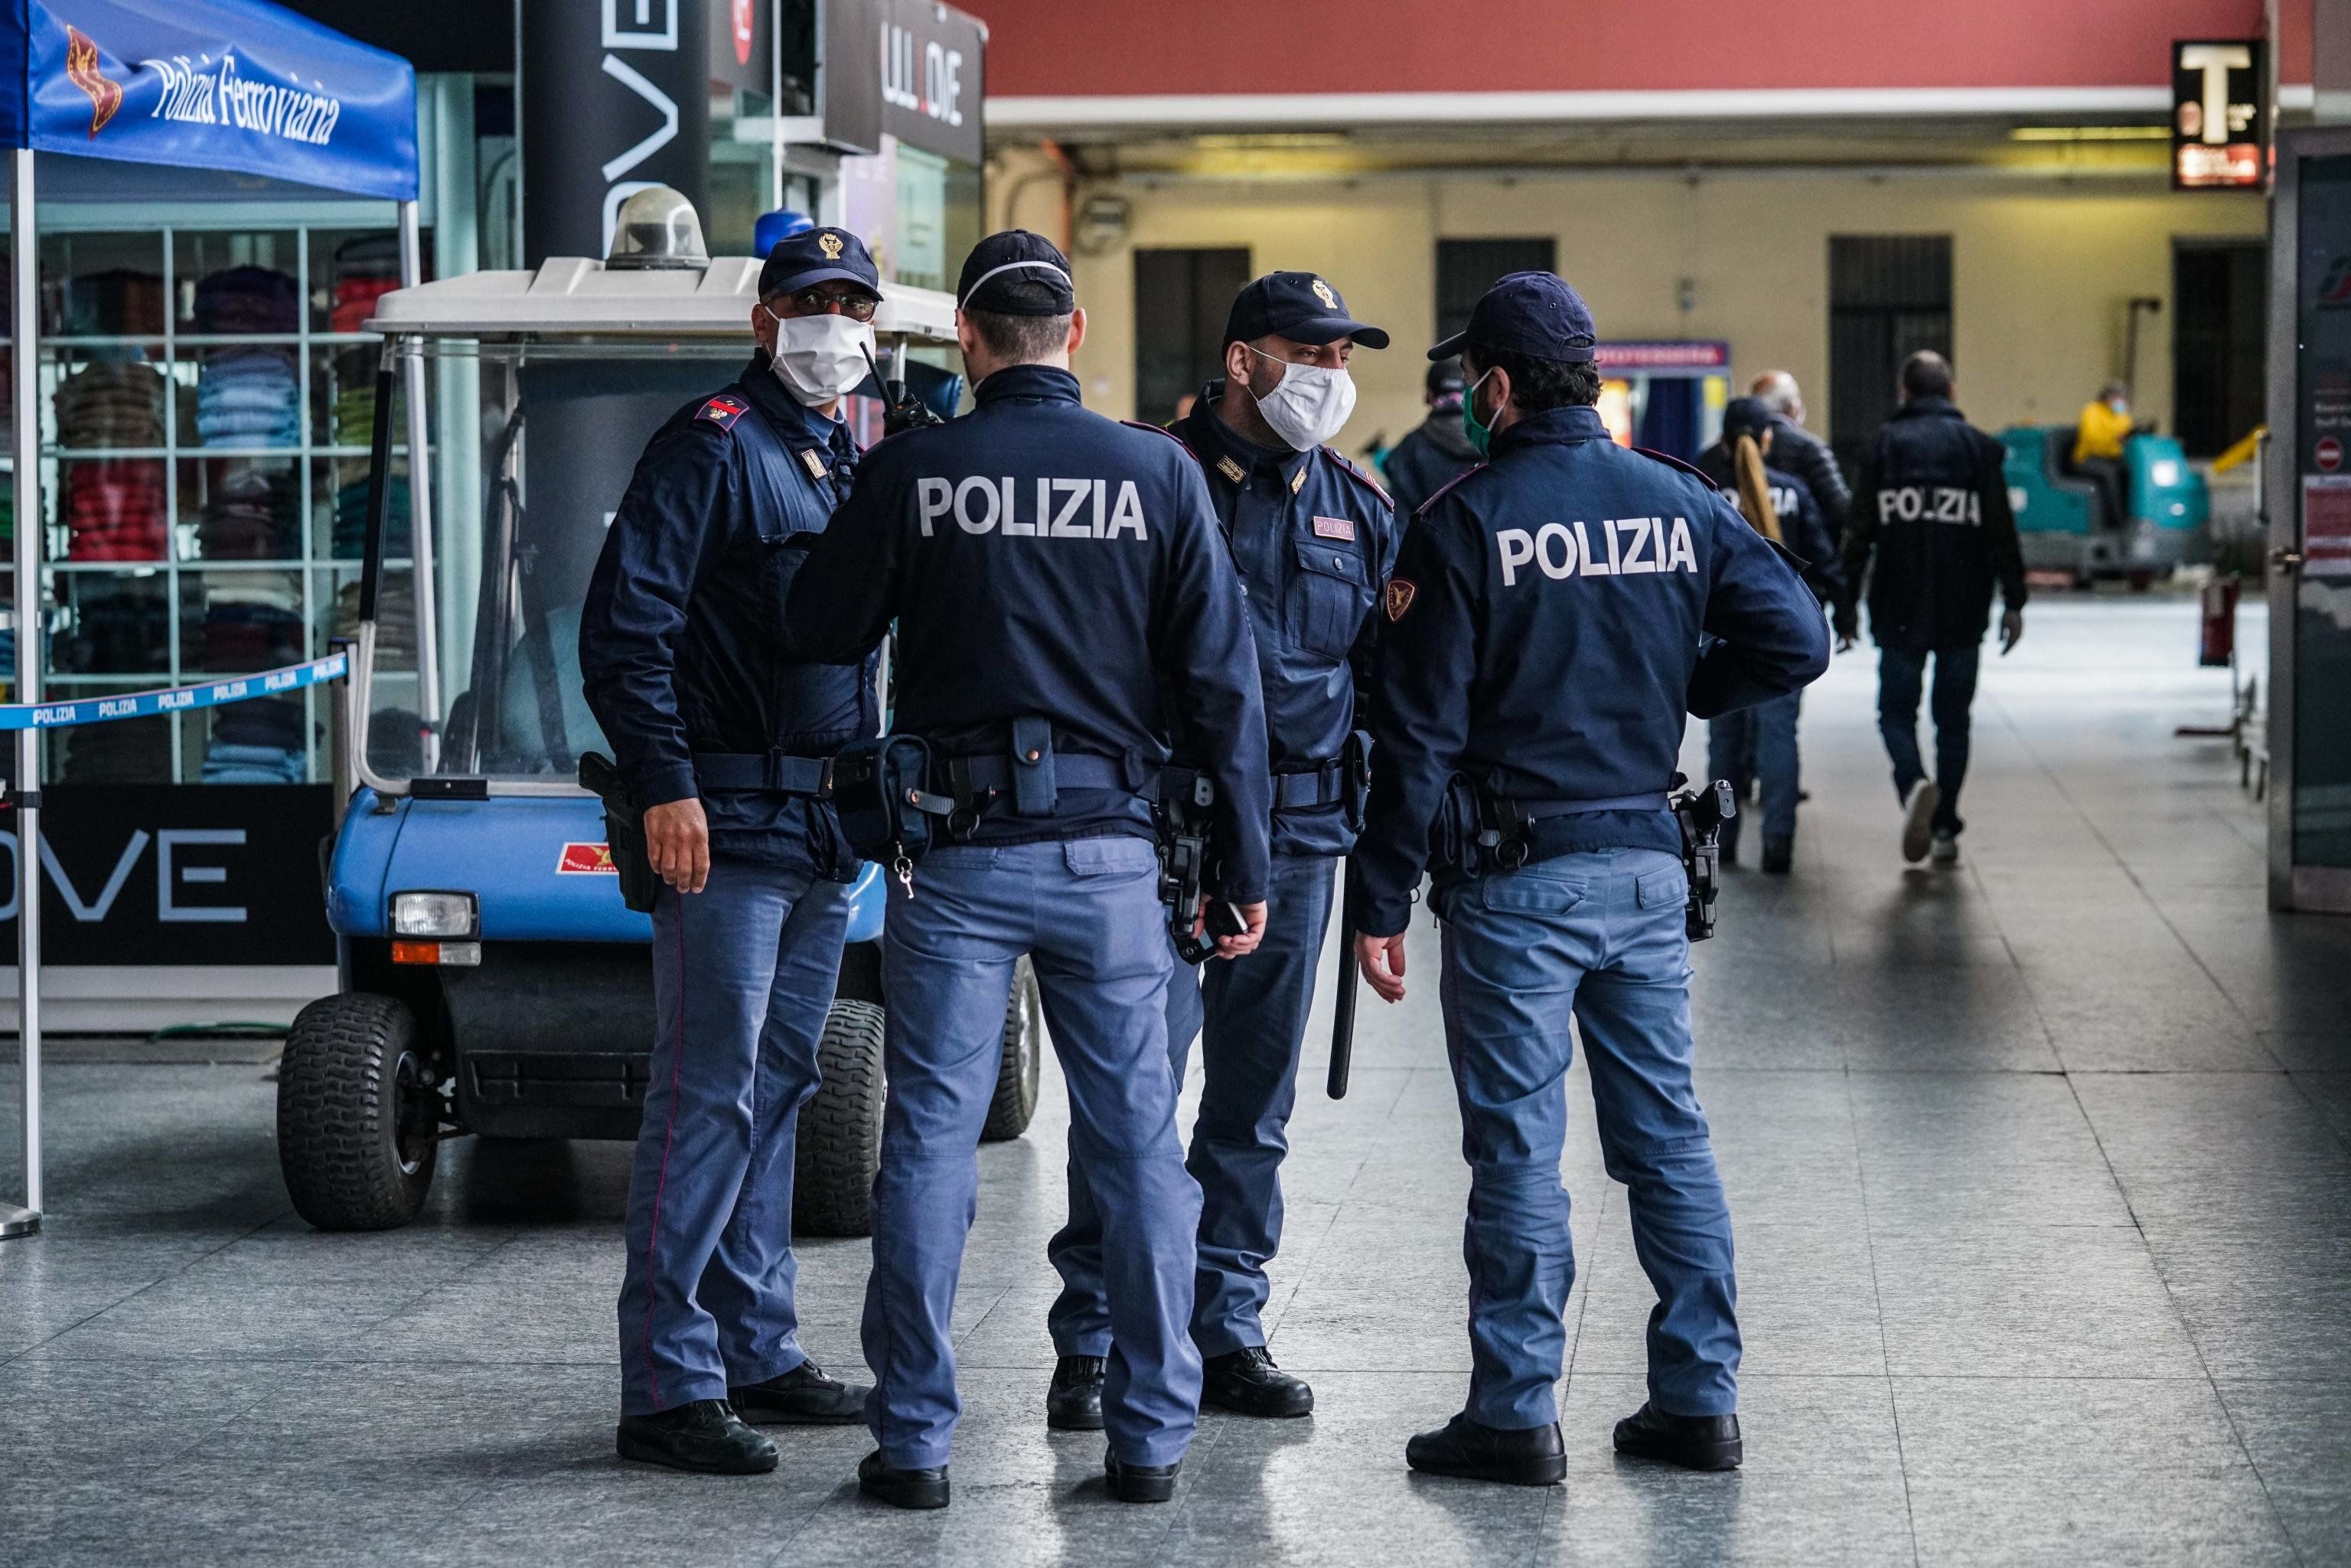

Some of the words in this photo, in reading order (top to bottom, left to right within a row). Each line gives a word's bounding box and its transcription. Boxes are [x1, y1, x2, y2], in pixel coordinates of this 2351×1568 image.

[139, 53, 217, 125] Polizia
[219, 54, 340, 145] Ferroviaria
[918, 475, 1148, 540] POLIZIA
[1316, 520, 1352, 536] POLIZIA
[1496, 517, 1697, 587] POLIZIA
[32, 705, 77, 726] POLIZIA
[99, 698, 138, 719] POLIZIA
[158, 689, 195, 710] POLIZIA
